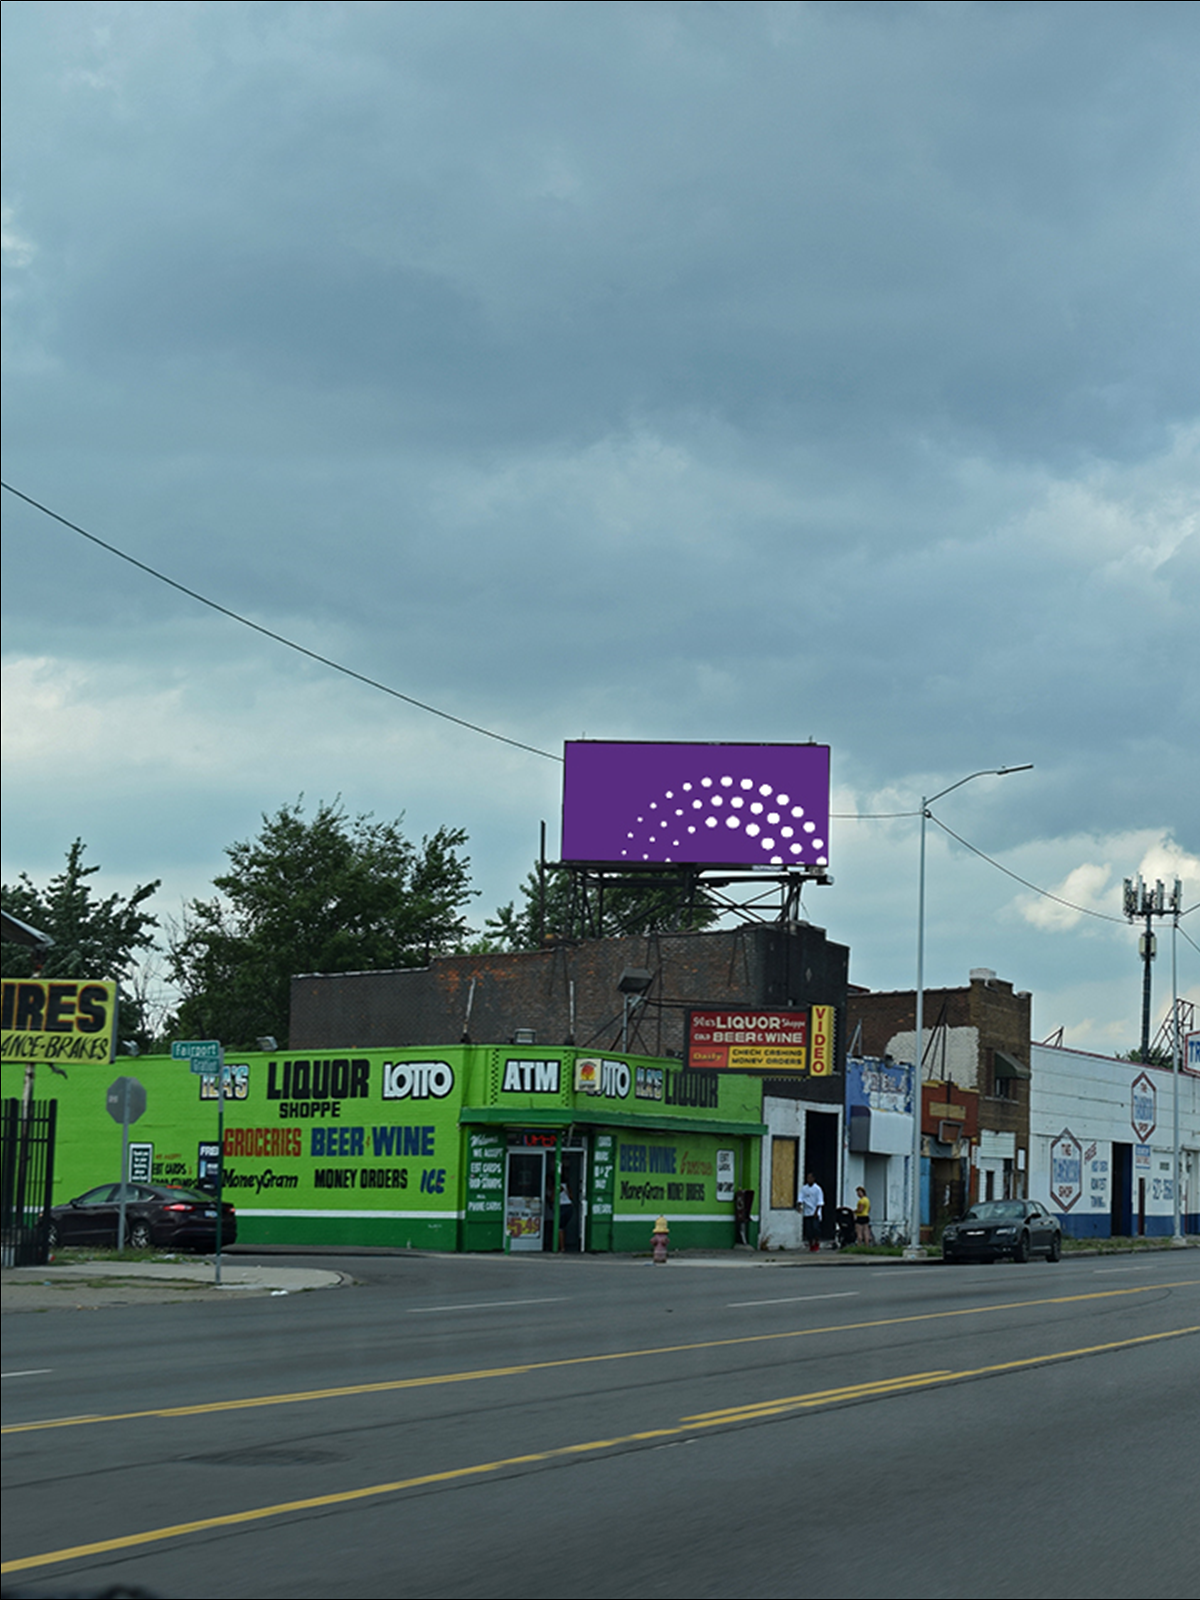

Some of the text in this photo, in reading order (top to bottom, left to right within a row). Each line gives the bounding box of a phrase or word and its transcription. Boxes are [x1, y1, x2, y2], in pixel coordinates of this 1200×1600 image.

[716, 1016, 781, 1030] LIQUOR
[712, 1031, 756, 1044] BEER
[764, 1032, 803, 1044] WINE
[812, 1007, 827, 1074] VIDEO
[175, 1043, 217, 1057] Fairport
[731, 1048, 803, 1058] CHECK CASHING
[731, 1057, 803, 1066] MONEY ORDERS
[267, 1059, 370, 1100] LIQUOR
[383, 1061, 453, 1099] LOTTO
[504, 1059, 560, 1093] ATM
[279, 1101, 341, 1119] SHOPPE
[223, 1128, 302, 1157] GROCERIES
[311, 1126, 364, 1157] BEER
[372, 1126, 435, 1157] WINE
[314, 1168, 357, 1188] MONEY
[360, 1168, 408, 1189] ORDERS
[420, 1169, 446, 1194] ICE
